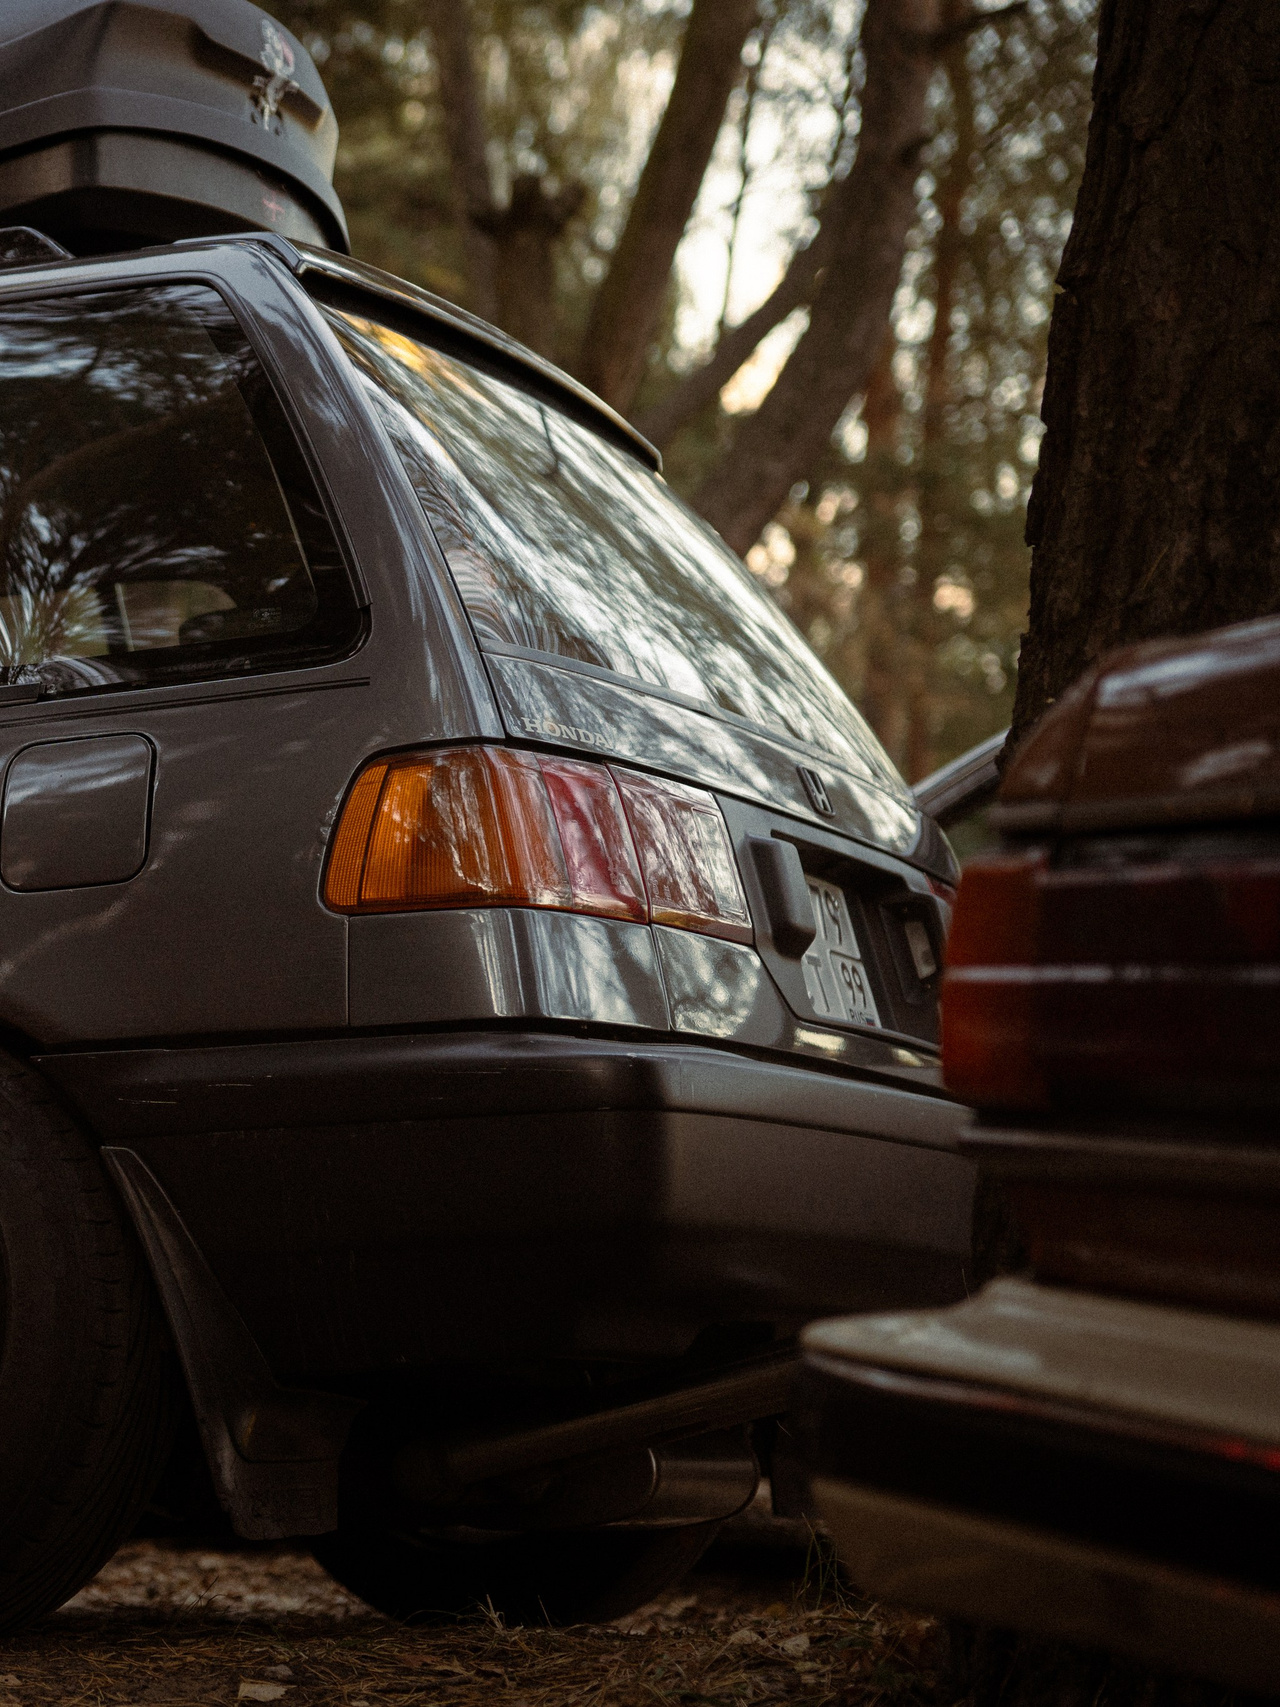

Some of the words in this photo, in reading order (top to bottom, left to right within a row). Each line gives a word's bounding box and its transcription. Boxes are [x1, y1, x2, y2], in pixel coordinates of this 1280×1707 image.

[521, 716, 613, 749] HONDA
[841, 961, 867, 1009] 99
[849, 1008, 865, 1024] RUS
